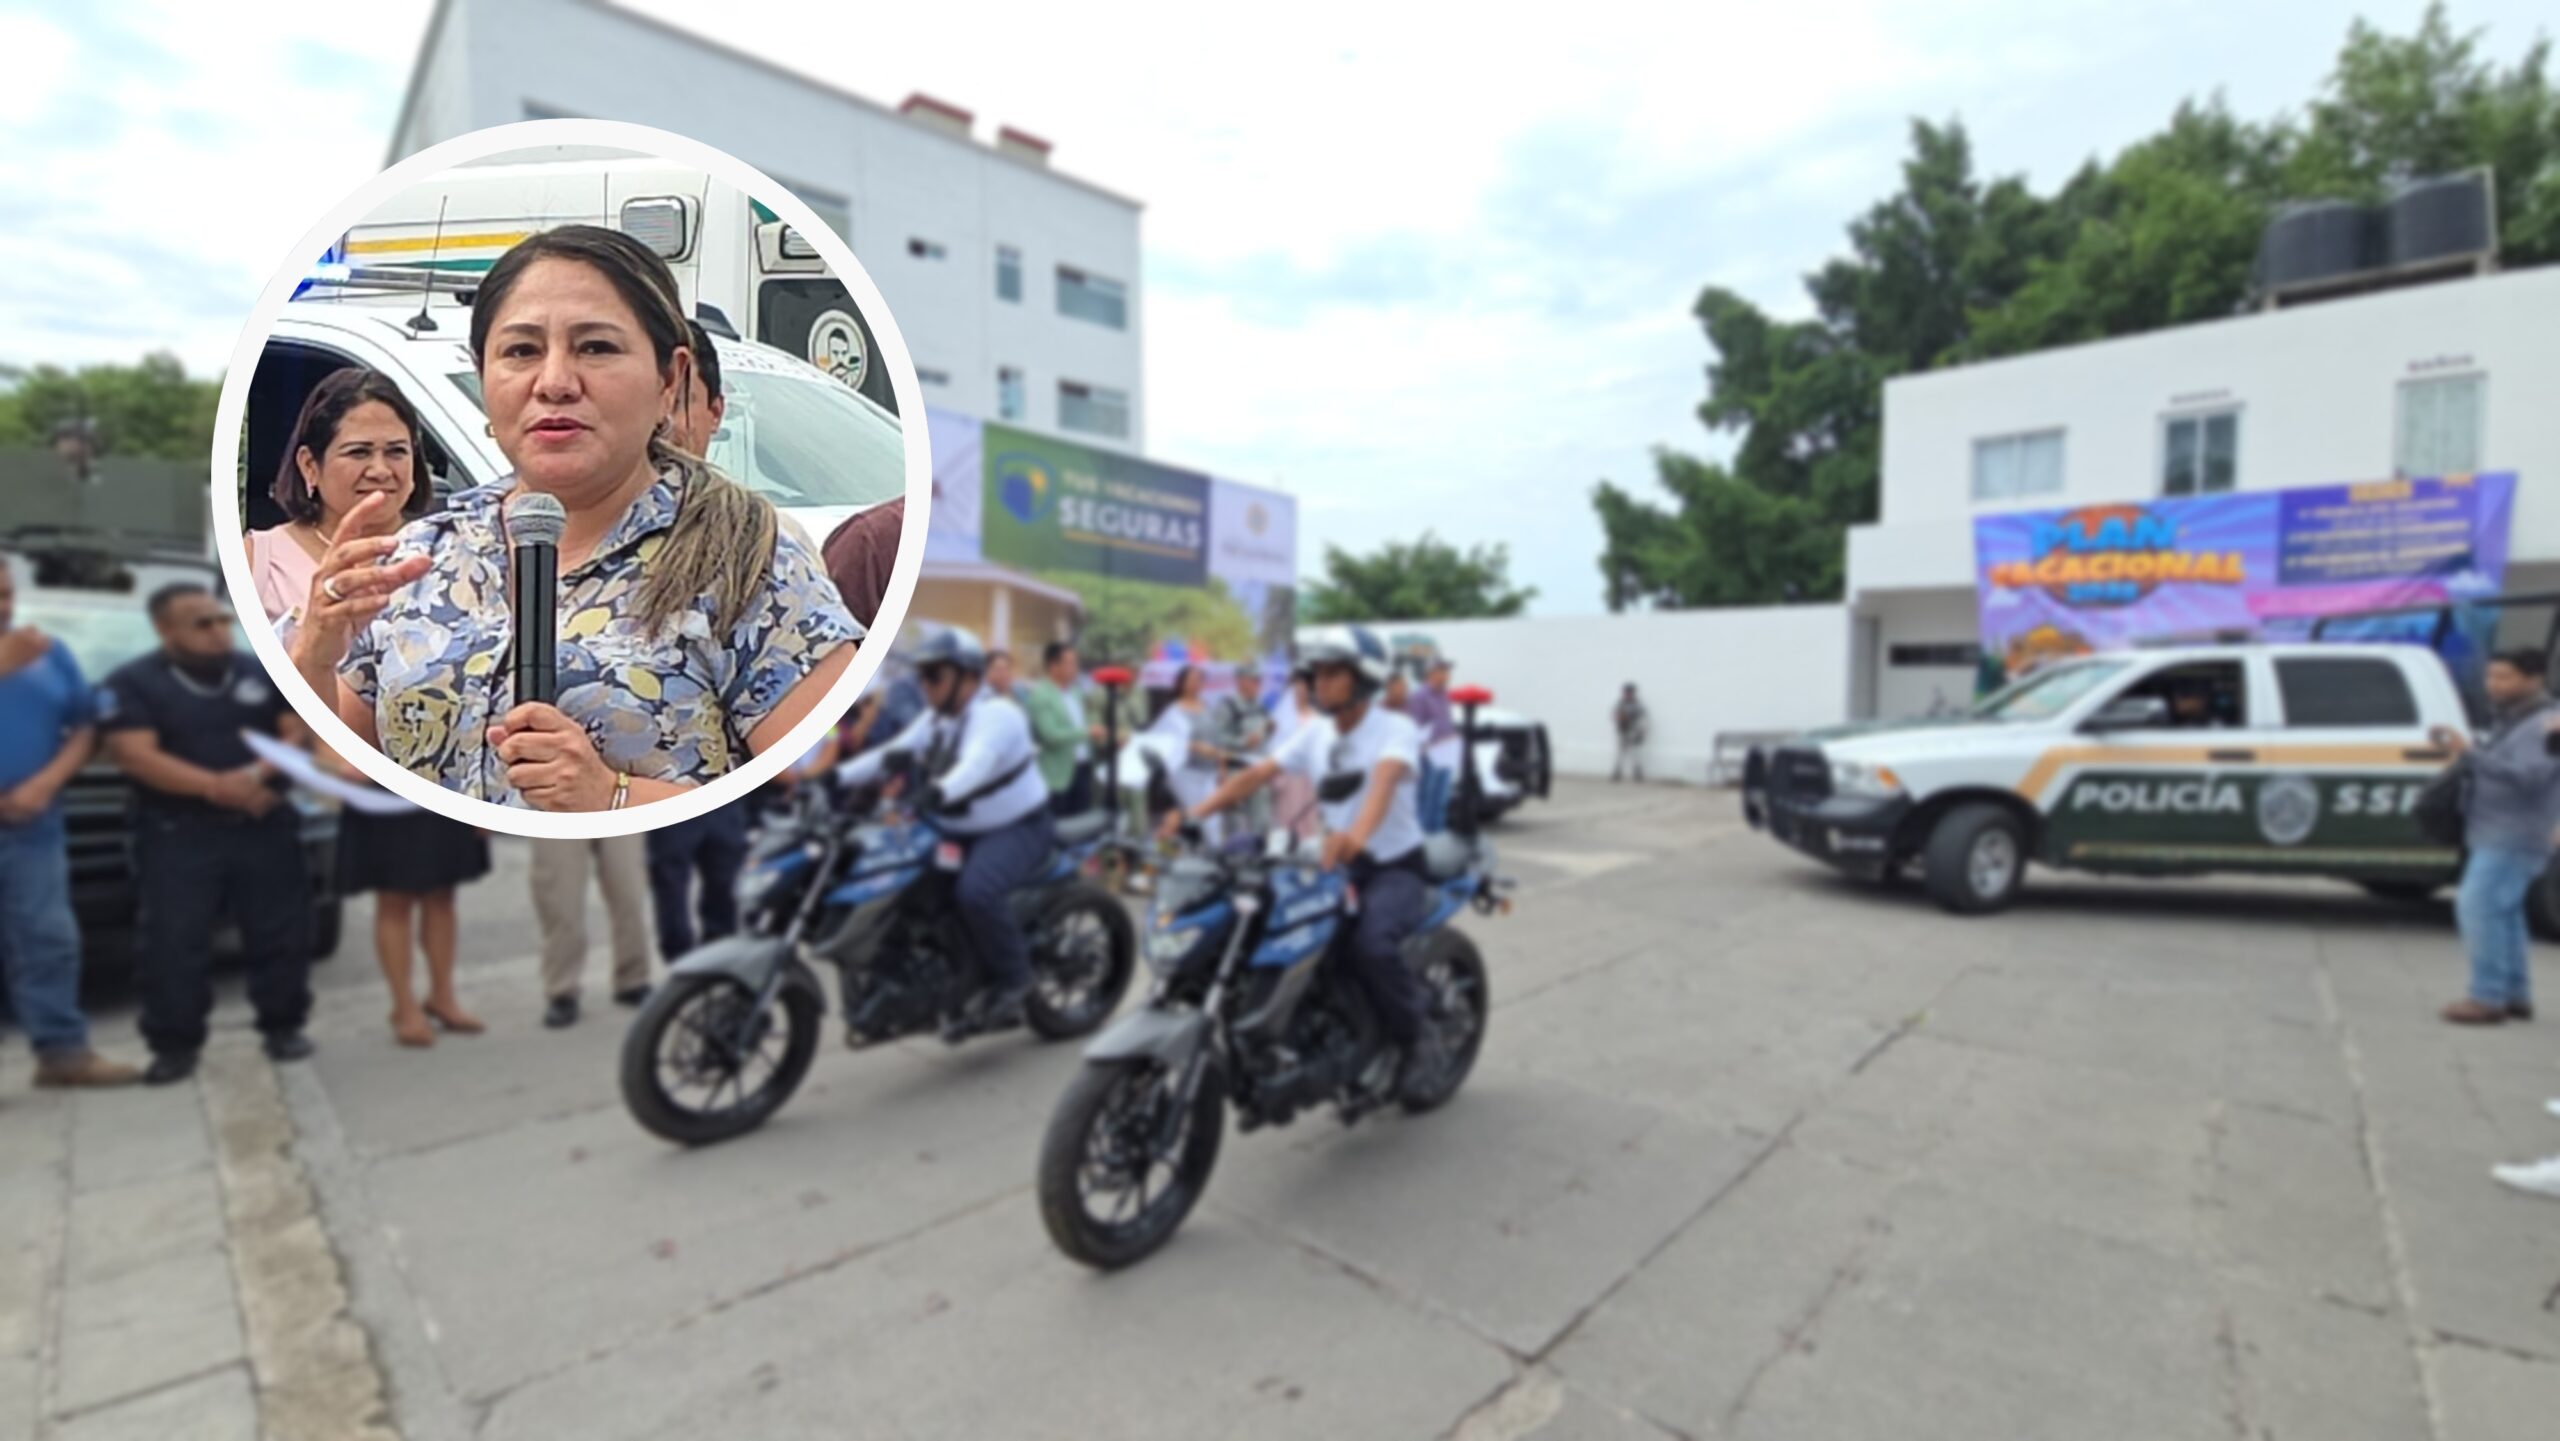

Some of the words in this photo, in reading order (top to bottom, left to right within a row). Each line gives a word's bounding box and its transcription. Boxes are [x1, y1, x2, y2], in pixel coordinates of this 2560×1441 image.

[1058, 495, 1201, 549] SEGURAS
[2030, 514, 2179, 562] PLAN
[2073, 771, 2244, 813] POLICÍA
